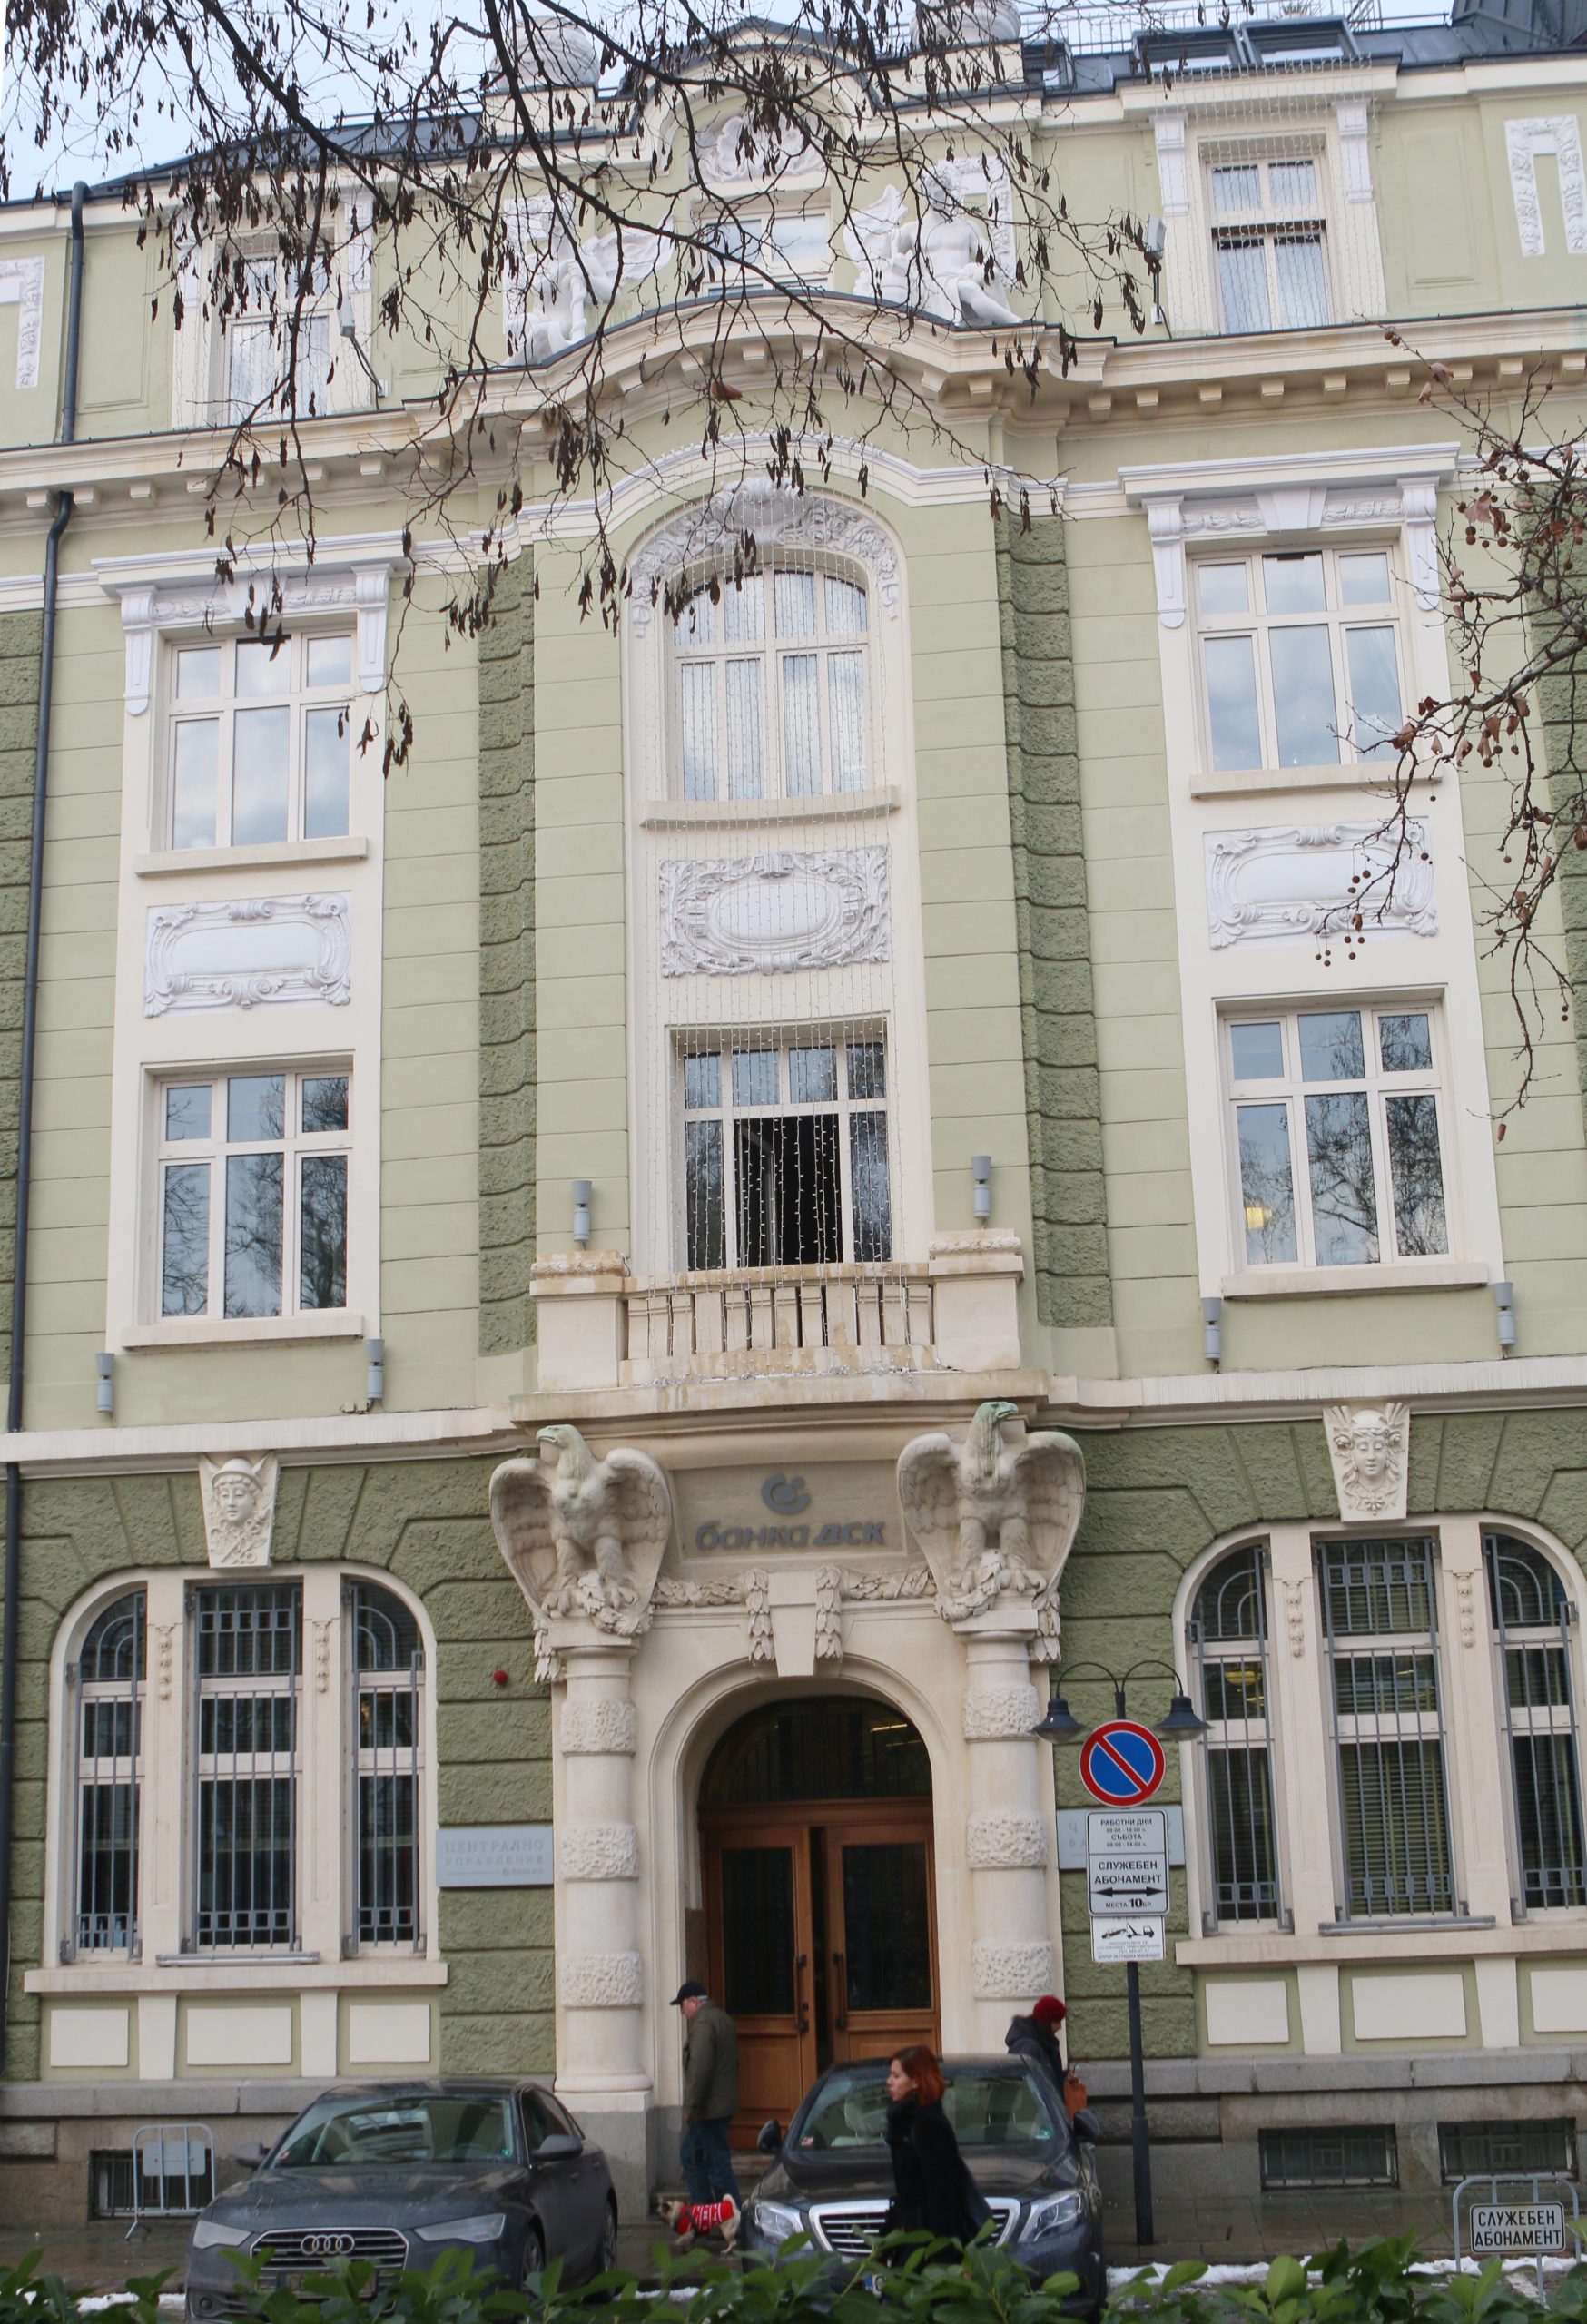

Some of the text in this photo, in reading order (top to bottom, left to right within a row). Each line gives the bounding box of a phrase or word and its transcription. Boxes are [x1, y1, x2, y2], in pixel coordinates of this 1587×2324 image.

[695, 1520, 810, 1551] банка
[445, 1839, 544, 1854] ЦЕНТРАЛНО
[445, 1855, 544, 1866] УПРАВЛЕНИЕ
[1098, 1861, 1158, 1871] СЛУЖЕБЕН
[1094, 1875, 1161, 1885] АБОНАМЕНТ
[1478, 2210, 1555, 2227] СЛУЖЕБЕН
[1474, 2230, 1561, 2247] АБОНАМЕНТ
